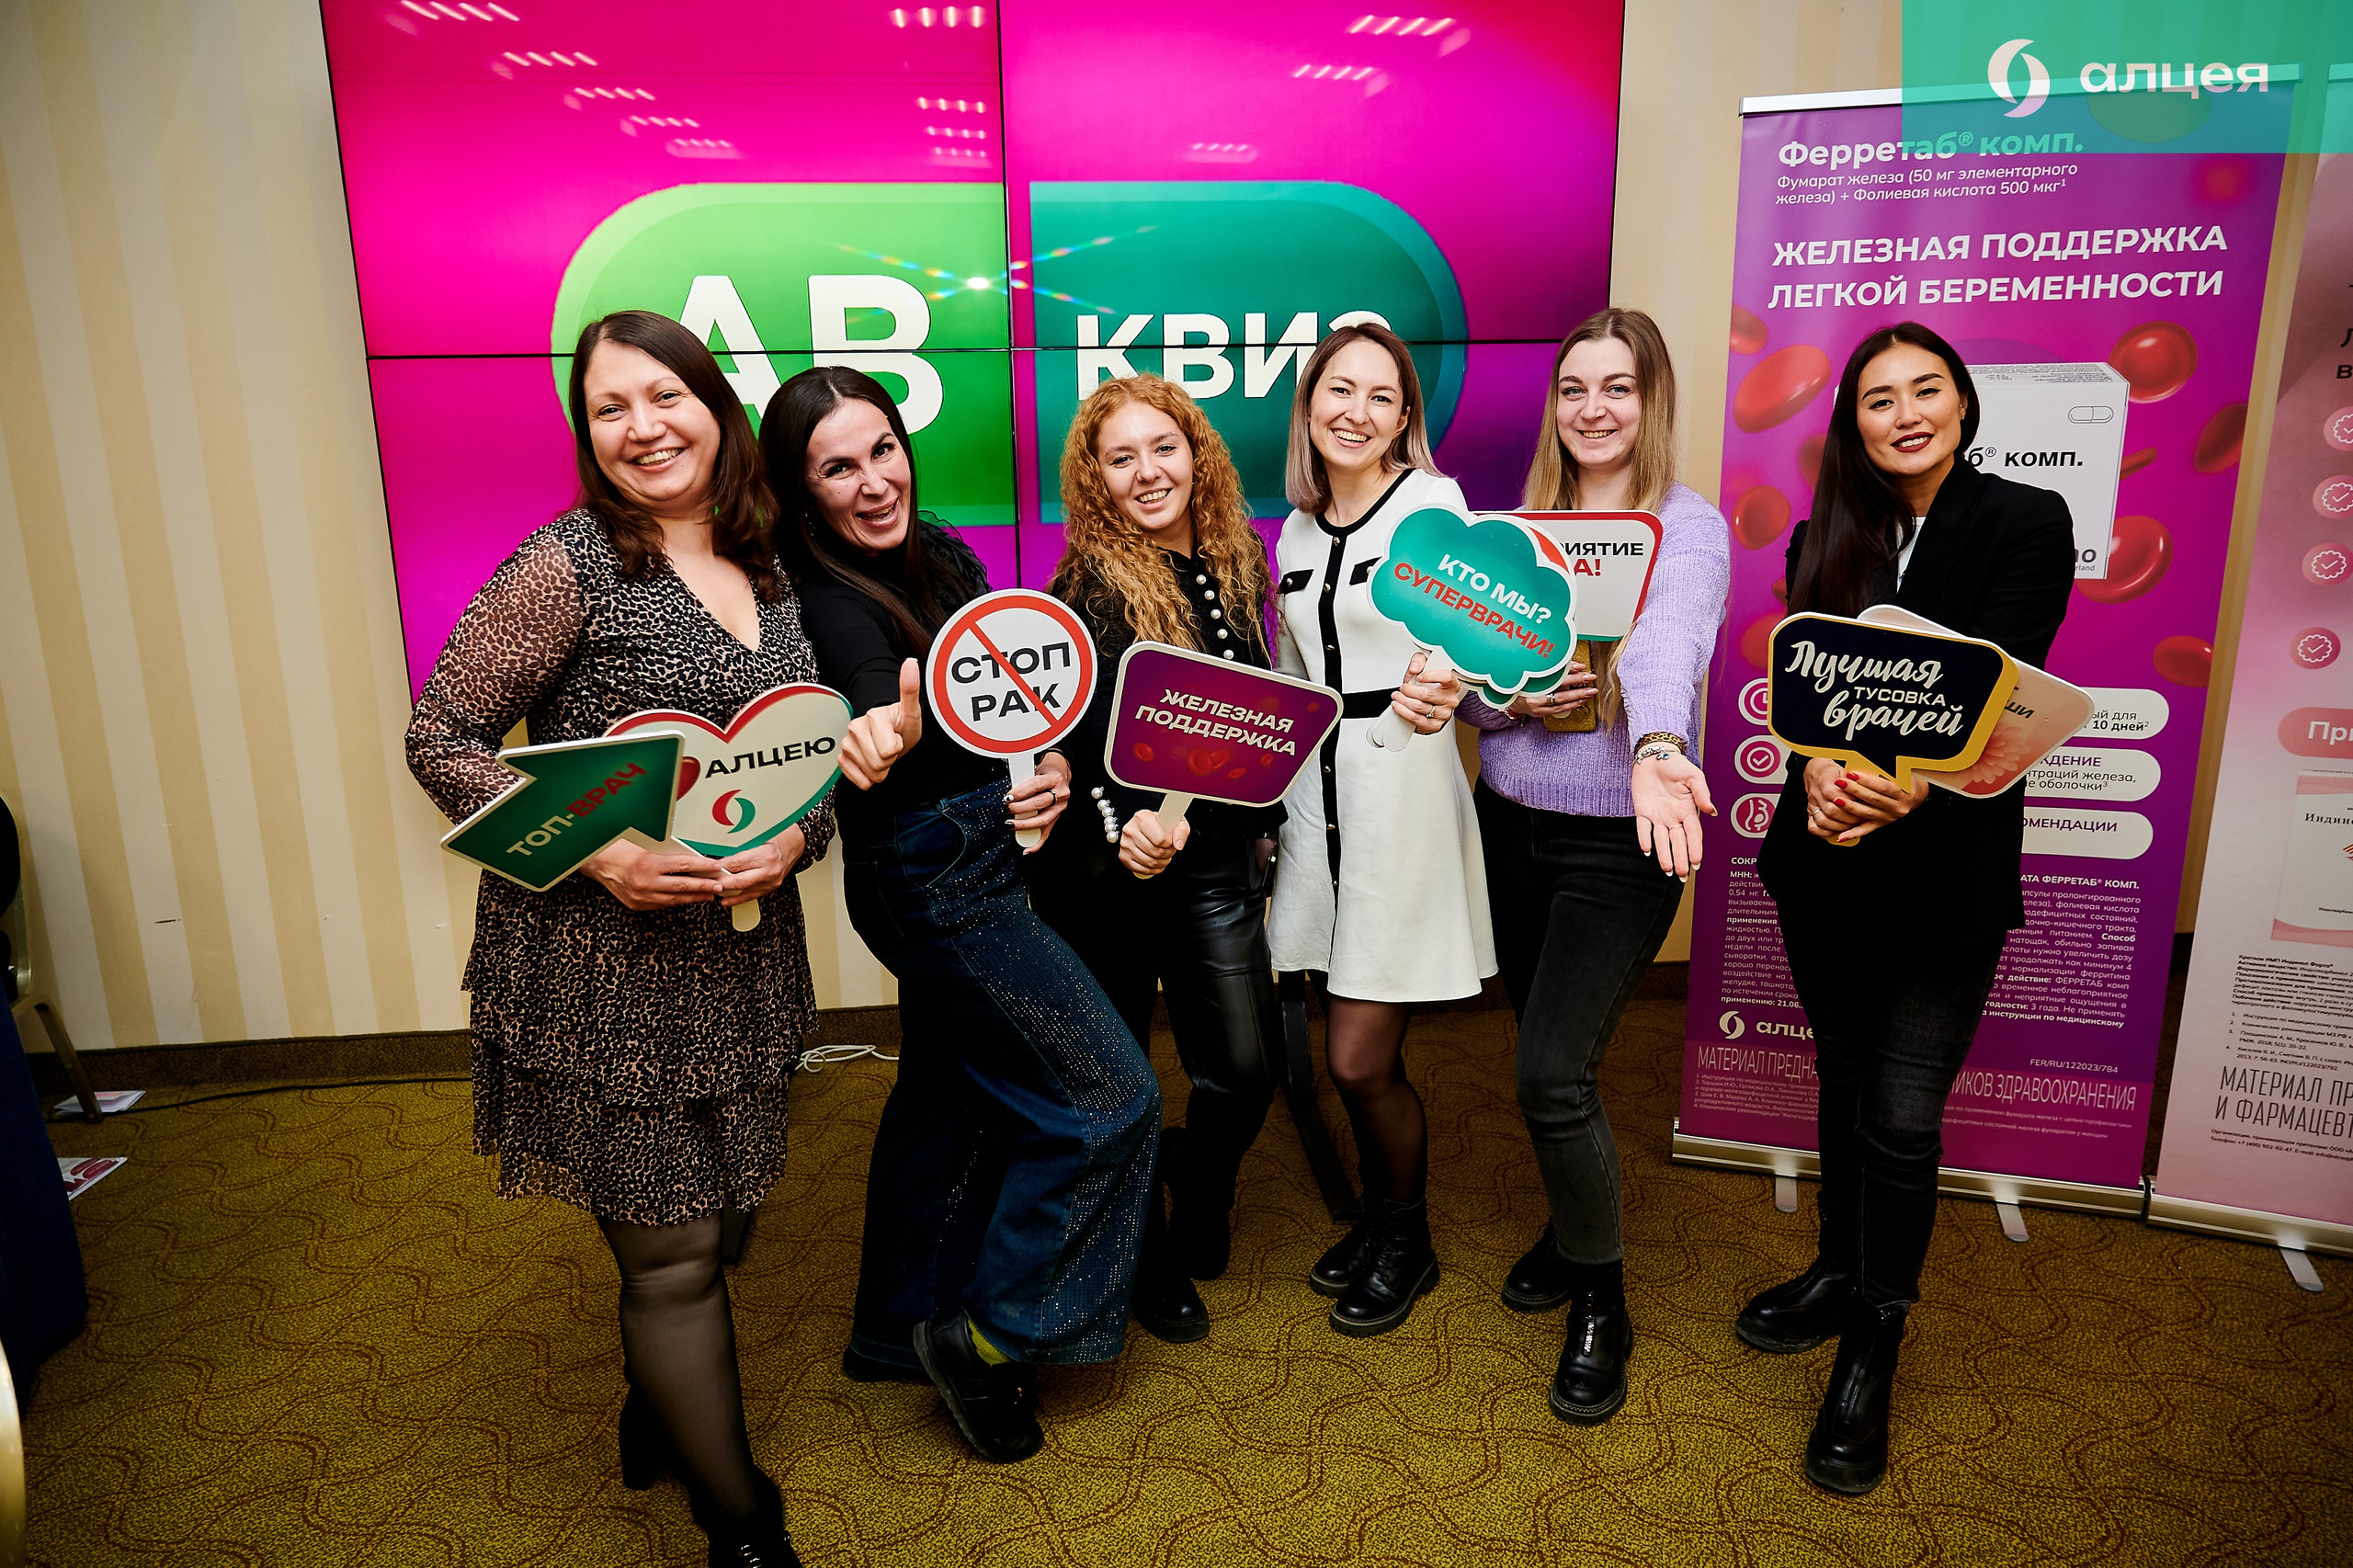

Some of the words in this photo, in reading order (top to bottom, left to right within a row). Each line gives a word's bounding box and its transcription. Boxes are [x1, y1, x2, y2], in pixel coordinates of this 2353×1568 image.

[1980, 132, 2086, 158] комп.
[1777, 174, 1844, 189] Фумарат
[1847, 172, 1904, 185] железа
[1908, 169, 1932, 185] (50
[1936, 169, 1954, 182] мг
[1958, 165, 2078, 181] элементарного
[1776, 191, 1836, 205] железа)
[1841, 192, 1849, 201] +
[1854, 187, 1929, 203] Фолиевая
[1933, 184, 1995, 198] кислота
[2000, 181, 2029, 195] 500
[1772, 234, 1971, 267] ЖЕЛЕЗНАЯ
[1981, 225, 2228, 261] ПОДДЕРЖКА
[1768, 275, 1908, 309] ЛЕГКОЙ
[1918, 270, 2224, 305] БЕРЕМЕННОСТИ
[1077, 311, 1390, 400] КВИ
[2004, 450, 2084, 468] комп.
[1560, 542, 1643, 556] ИЯТИЕ
[1437, 553, 1491, 592] КТО
[1489, 583, 1552, 624] МЫ?
[1393, 562, 1556, 659] СУПЕРВРАЧИ!
[950, 641, 1071, 685] СТОП
[1784, 640, 1944, 694] Лучшая
[971, 683, 1062, 722] РАК
[1855, 686, 1946, 707] ТУСОВКА
[1160, 688, 1295, 734] ЖЕЛЕЗНАЯ
[1824, 690, 1963, 742] врачей
[2111, 711, 2137, 721] для
[1134, 705, 1297, 756] ПОДДЕРЖКА
[2092, 721, 2108, 730] 10
[704, 736, 836, 779] АЛЦЕЮ
[2082, 772, 2136, 783] железа,
[506, 761, 649, 858] ТОП-ВРАЧ
[1731, 857, 1757, 865] СОКР
[2104, 880, 2140, 890] КОМП.
[2052, 892, 2141, 904] пролонгированного
[2055, 901, 2100, 910] фолиевая
[2103, 905, 2140, 914] кислота
[2054, 939, 2092, 949] обильно
[2097, 943, 2134, 951] запивая
[2101, 933, 2136, 942] Способ
[2010, 956, 2063, 965] продолжать
[2084, 961, 2123, 971] минимум
[2063, 950, 2109, 960] увеличить
[2007, 974, 2052, 983] действие:
[2055, 977, 2103, 987] ФЕРРЕТАБ
[2012, 966, 2075, 975] нормализации
[2080, 970, 2131, 981] ферритина
[1733, 988, 1773, 996] истечении
[1775, 991, 1799, 999] срока
[2002, 983, 2048, 993] временное
[2052, 986, 2128, 1000] неблагоприятное
[2015, 994, 2066, 1004] неприятные
[2070, 998, 2117, 1007] ощущения
[1721, 996, 1775, 1006] применению:
[1985, 1001, 2029, 1010] годности:
[2077, 1007, 2125, 1018] применять
[1989, 1011, 2041, 1019] инструкции
[2056, 1015, 2124, 1028] медицинскому
[1756, 1021, 1813, 1040] алце
[1698, 1046, 1765, 1074] МАТЕРИАЛ
[1767, 1051, 1819, 1084] ПРЕДНА
[2029, 1059, 2118, 1074] FER/RU/122023/784
[1995, 1074, 2137, 1111] ЗДРАВООХРАНЕНИЯ
[2220, 1065, 2323, 1103] МАТЕРИАЛ
[1984, 1120, 2017, 1130] состояний
[2215, 1096, 2228, 1120] И
[2236, 1098, 2353, 1139] ФАРМАЦЕВТ
